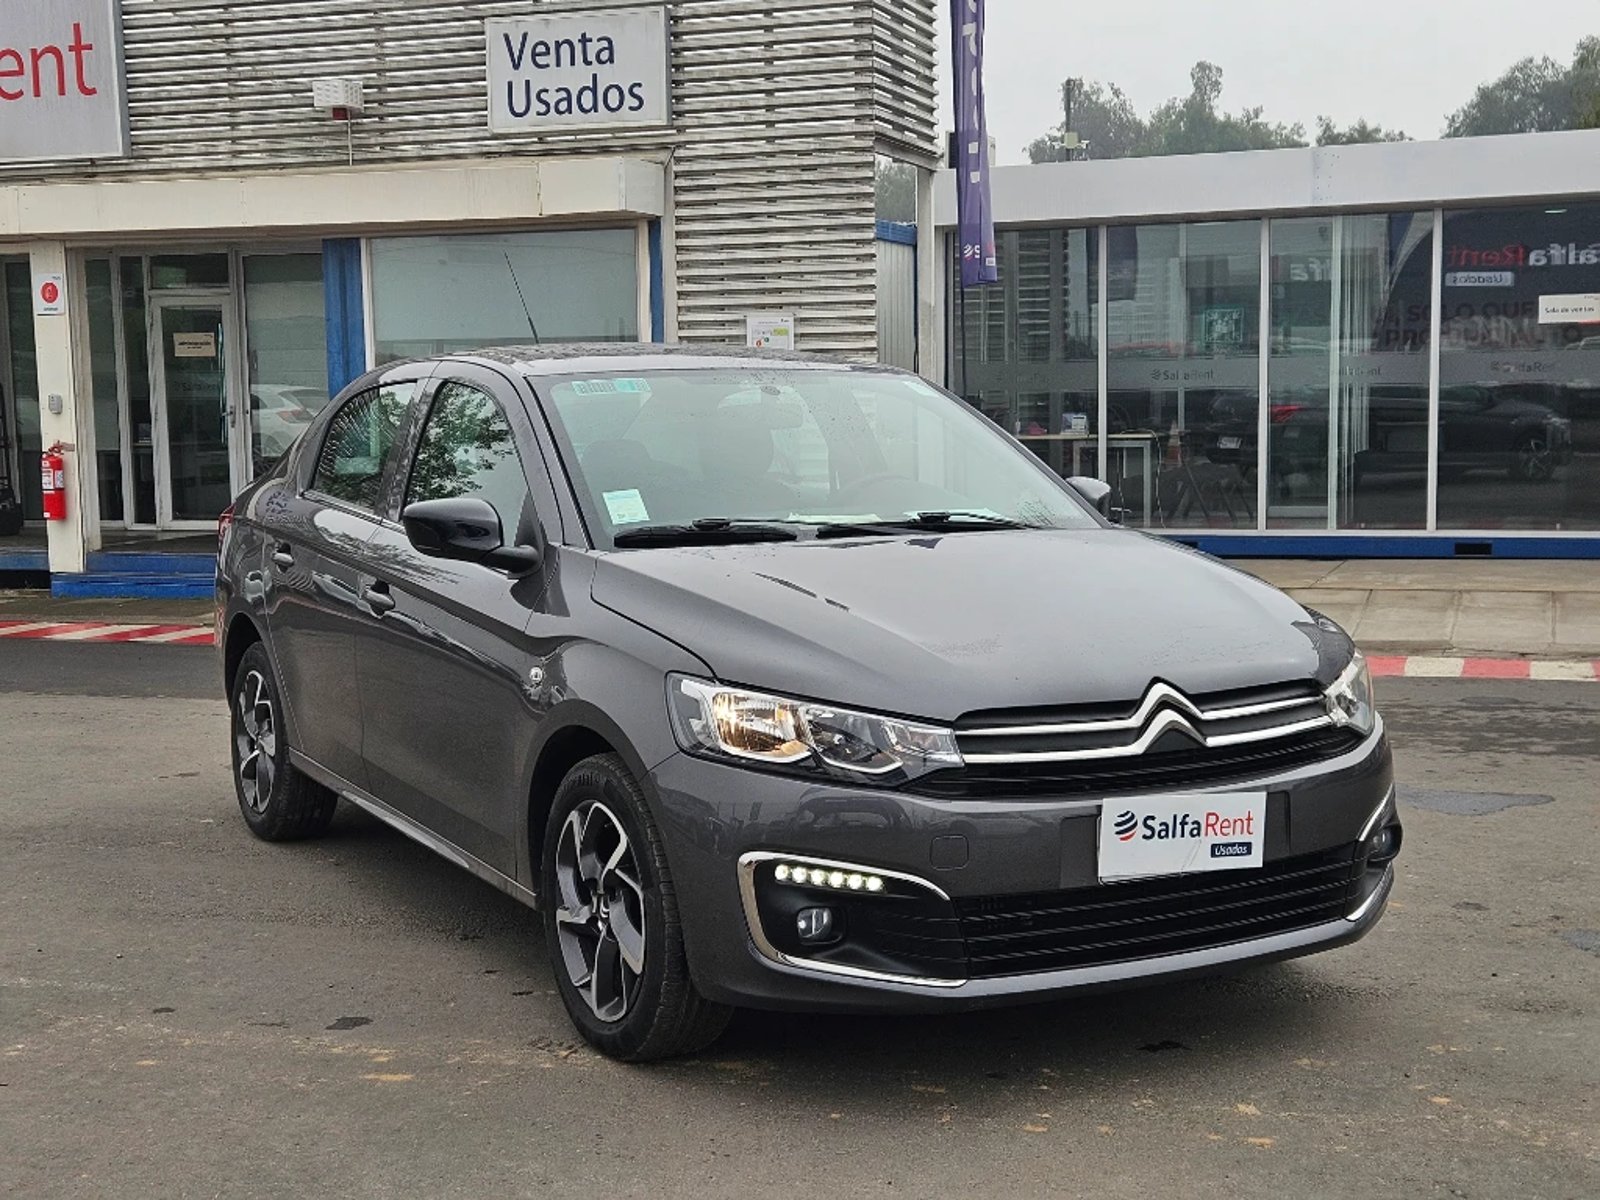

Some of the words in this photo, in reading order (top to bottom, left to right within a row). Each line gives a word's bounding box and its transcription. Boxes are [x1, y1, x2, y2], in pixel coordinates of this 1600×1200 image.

[503, 32, 615, 70] Venta
[507, 73, 645, 118] Usados
[1162, 367, 1214, 381] SalaRent
[1141, 809, 1254, 840] SalfaRent
[1214, 844, 1248, 856] Usados
